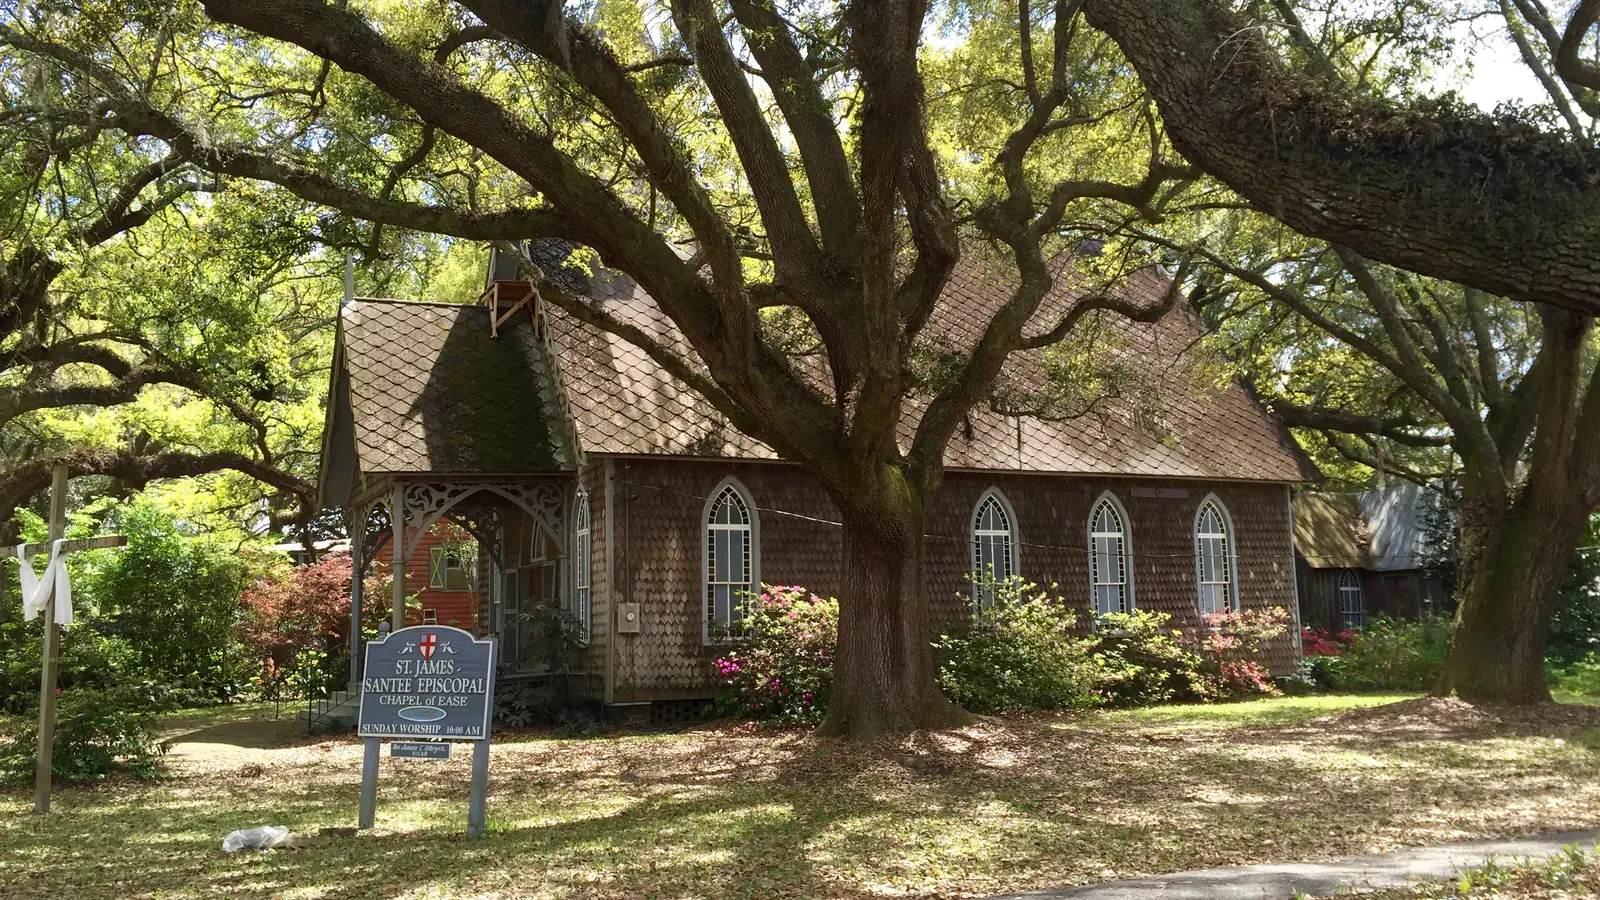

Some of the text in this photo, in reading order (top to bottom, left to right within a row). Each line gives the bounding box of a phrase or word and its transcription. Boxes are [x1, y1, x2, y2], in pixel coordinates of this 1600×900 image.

[395, 660, 412, 675] ST.
[414, 660, 454, 677] JAMES
[365, 678, 486, 694] SANTEE EPISCOPAL
[379, 695, 468, 707] CHAPEL of EASE
[362, 723, 480, 735] SUNDAY WORSHIP 10:00 AM
